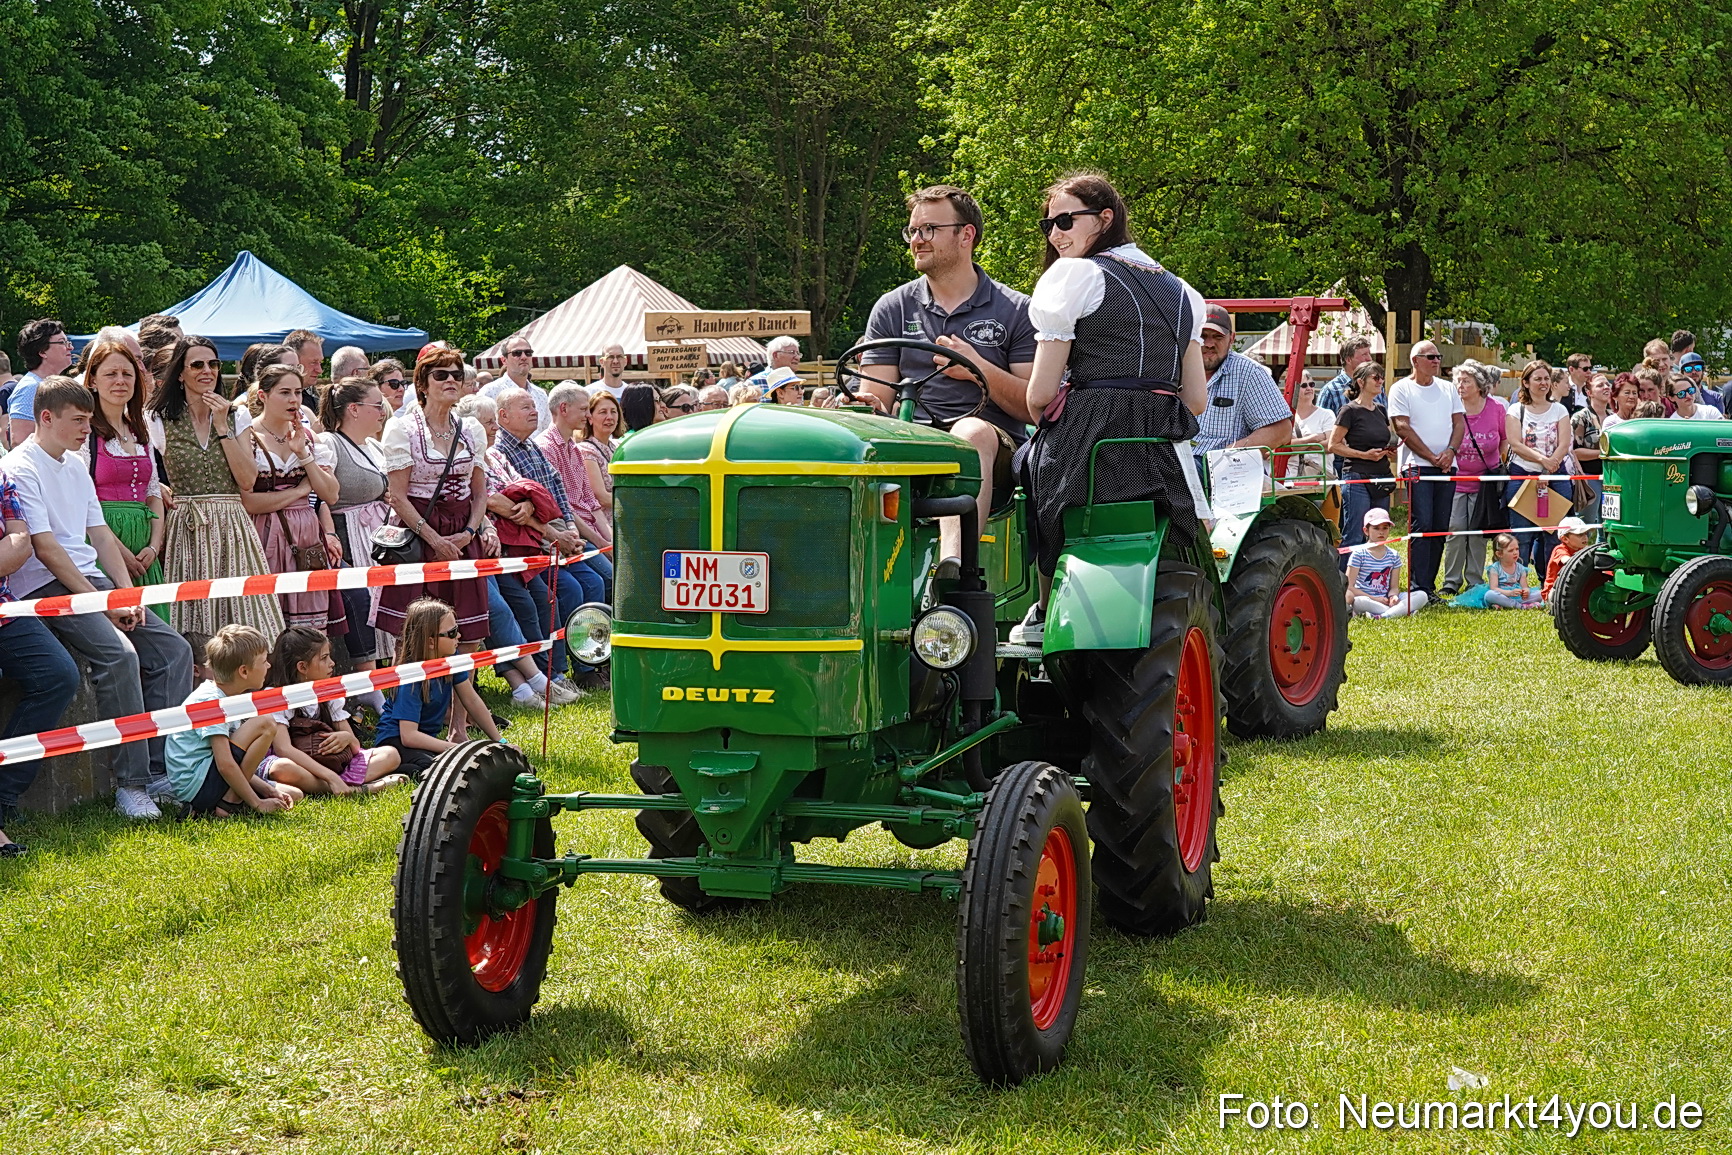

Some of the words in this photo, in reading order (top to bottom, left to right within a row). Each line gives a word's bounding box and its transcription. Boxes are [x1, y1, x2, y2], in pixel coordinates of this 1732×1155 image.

[693, 317, 754, 333] Haubner's
[758, 316, 797, 331] Ranch
[670, 568, 677, 577] D
[685, 556, 718, 581] NM
[676, 582, 756, 608] 07031
[662, 686, 776, 704] DEUTZ
